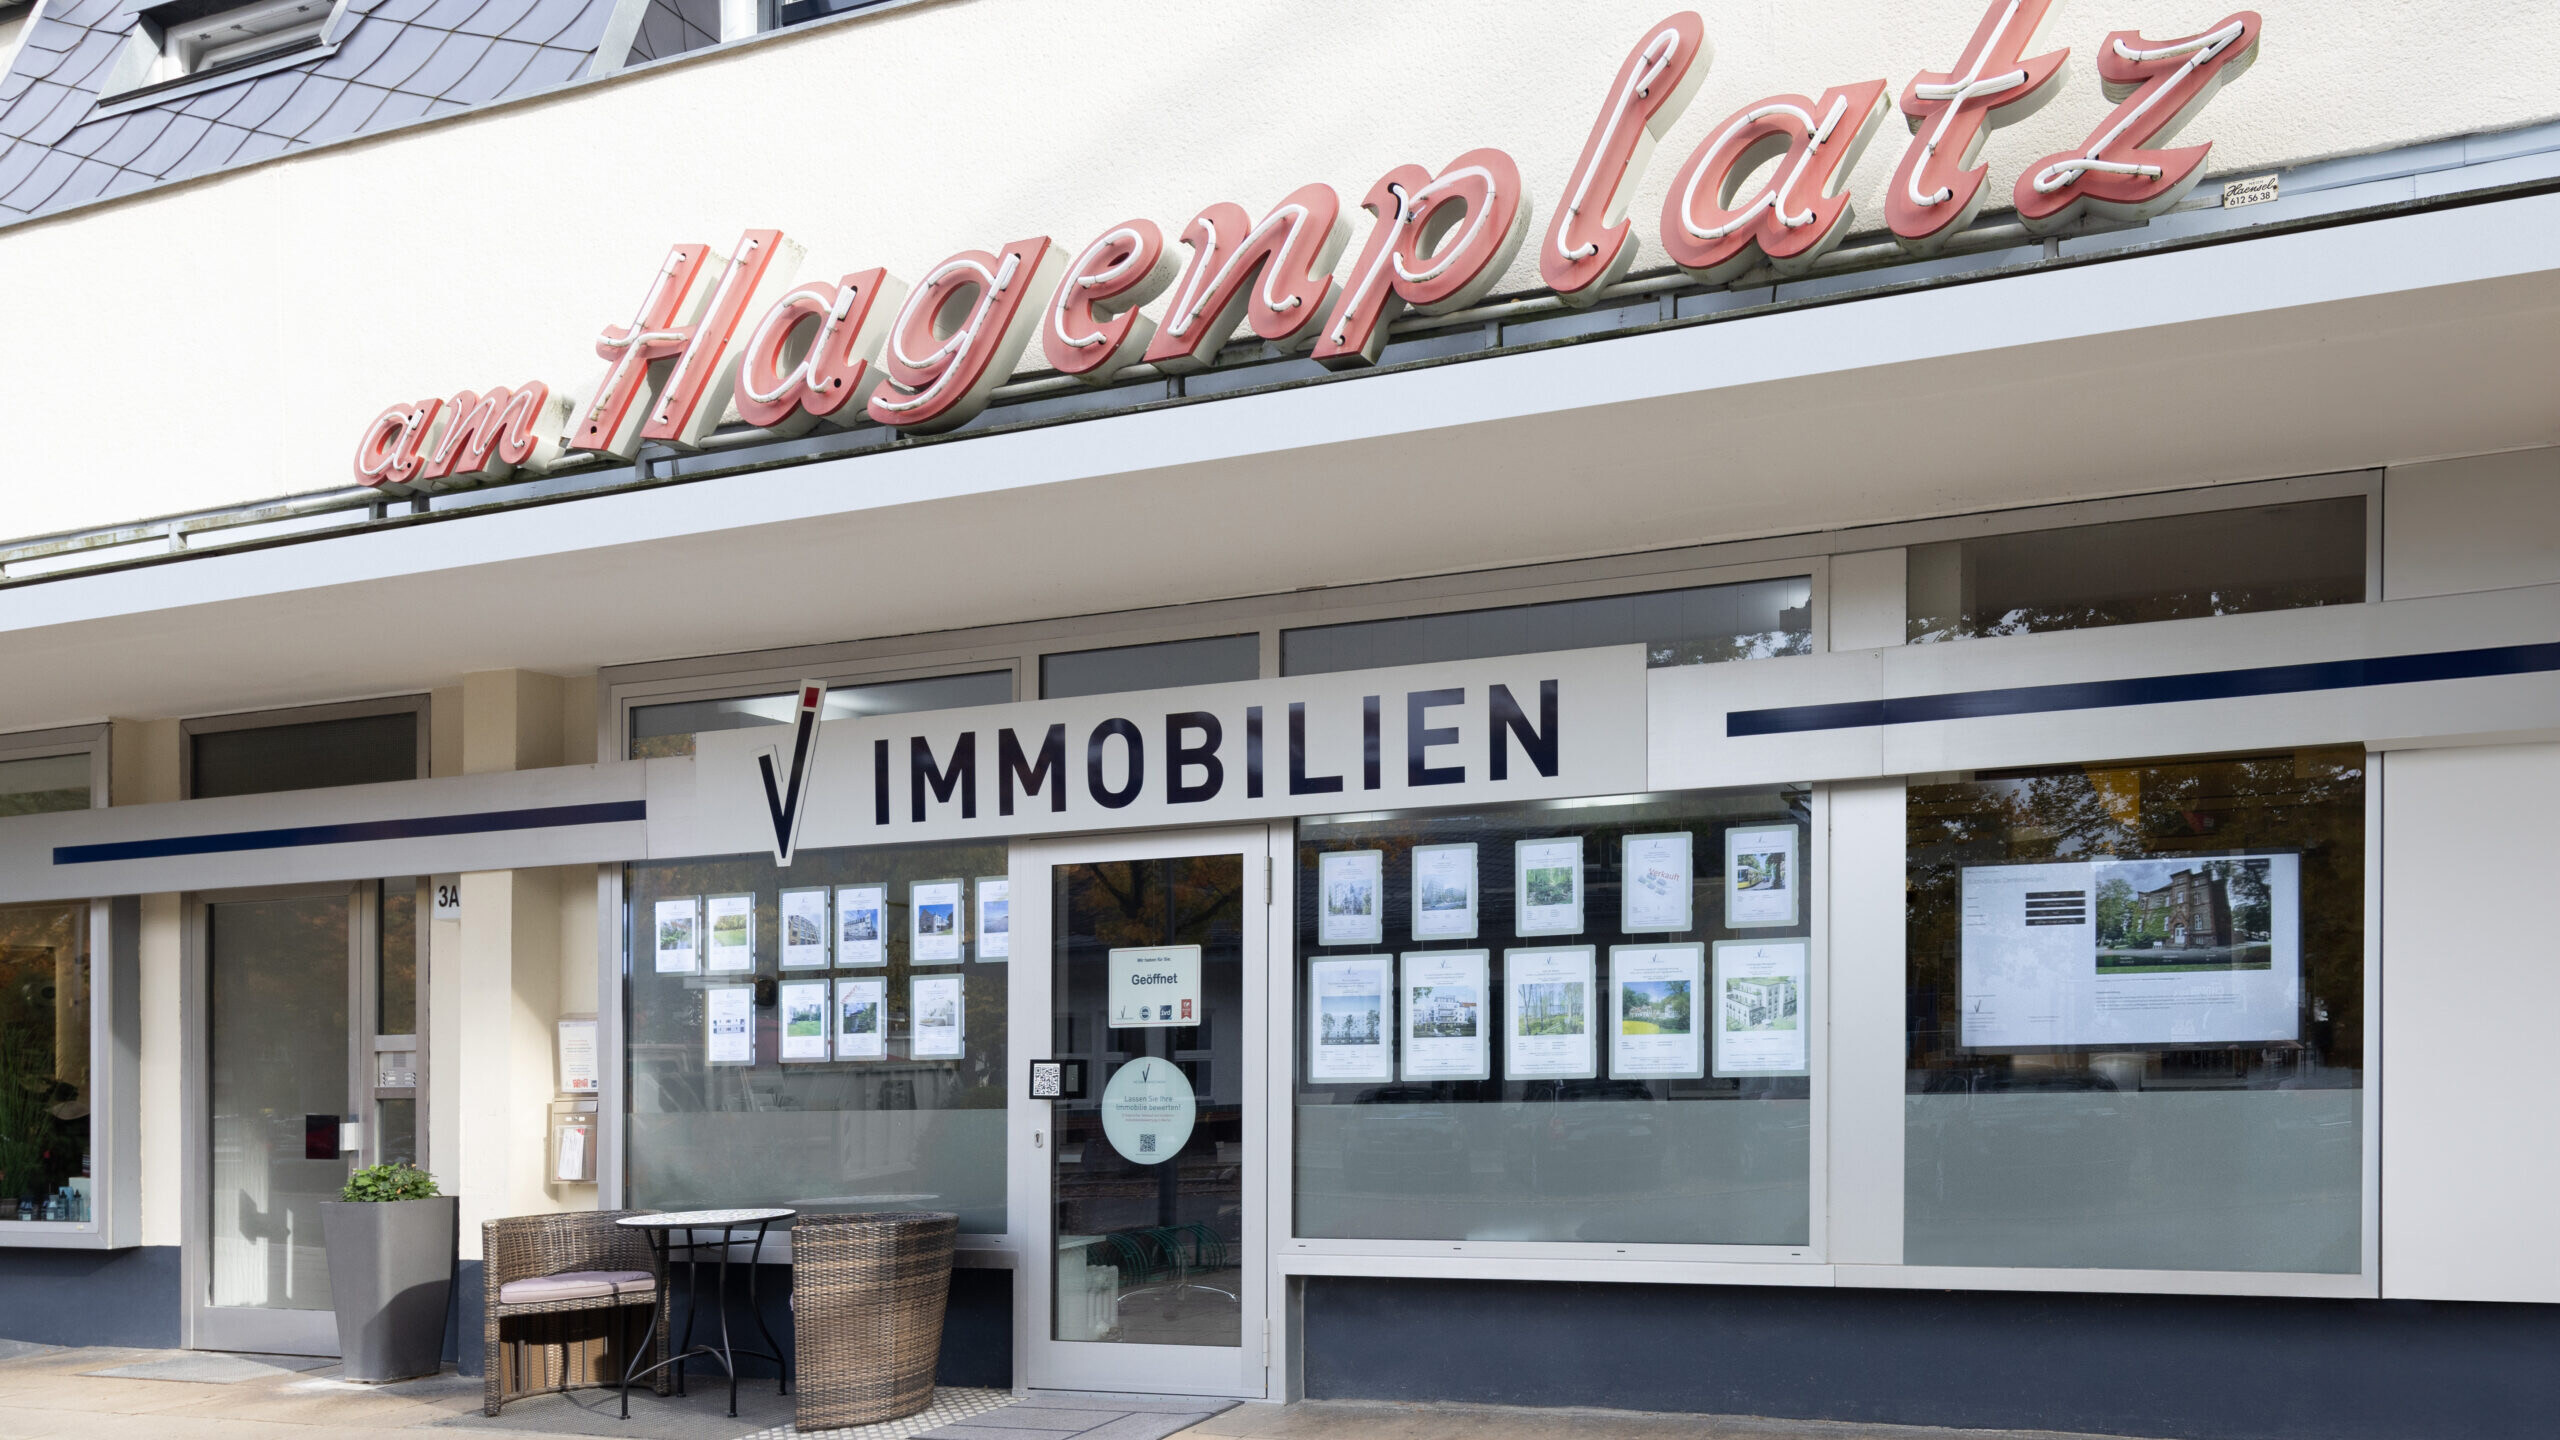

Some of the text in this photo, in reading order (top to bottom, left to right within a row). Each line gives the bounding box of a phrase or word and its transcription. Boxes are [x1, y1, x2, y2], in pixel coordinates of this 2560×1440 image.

[2226, 177, 2276, 198] Haensel
[2230, 191, 2271, 206] 612 56 38
[354, 0, 2263, 487] am Hagenplatz
[874, 678, 1559, 826] IMMOBILIEN
[438, 884, 460, 908] 3A
[1131, 973, 1178, 985] Geöffnet
[1124, 1095, 1173, 1103] Lassen Sie Ihre
[1148, 1104, 1181, 1112] bewerten!
